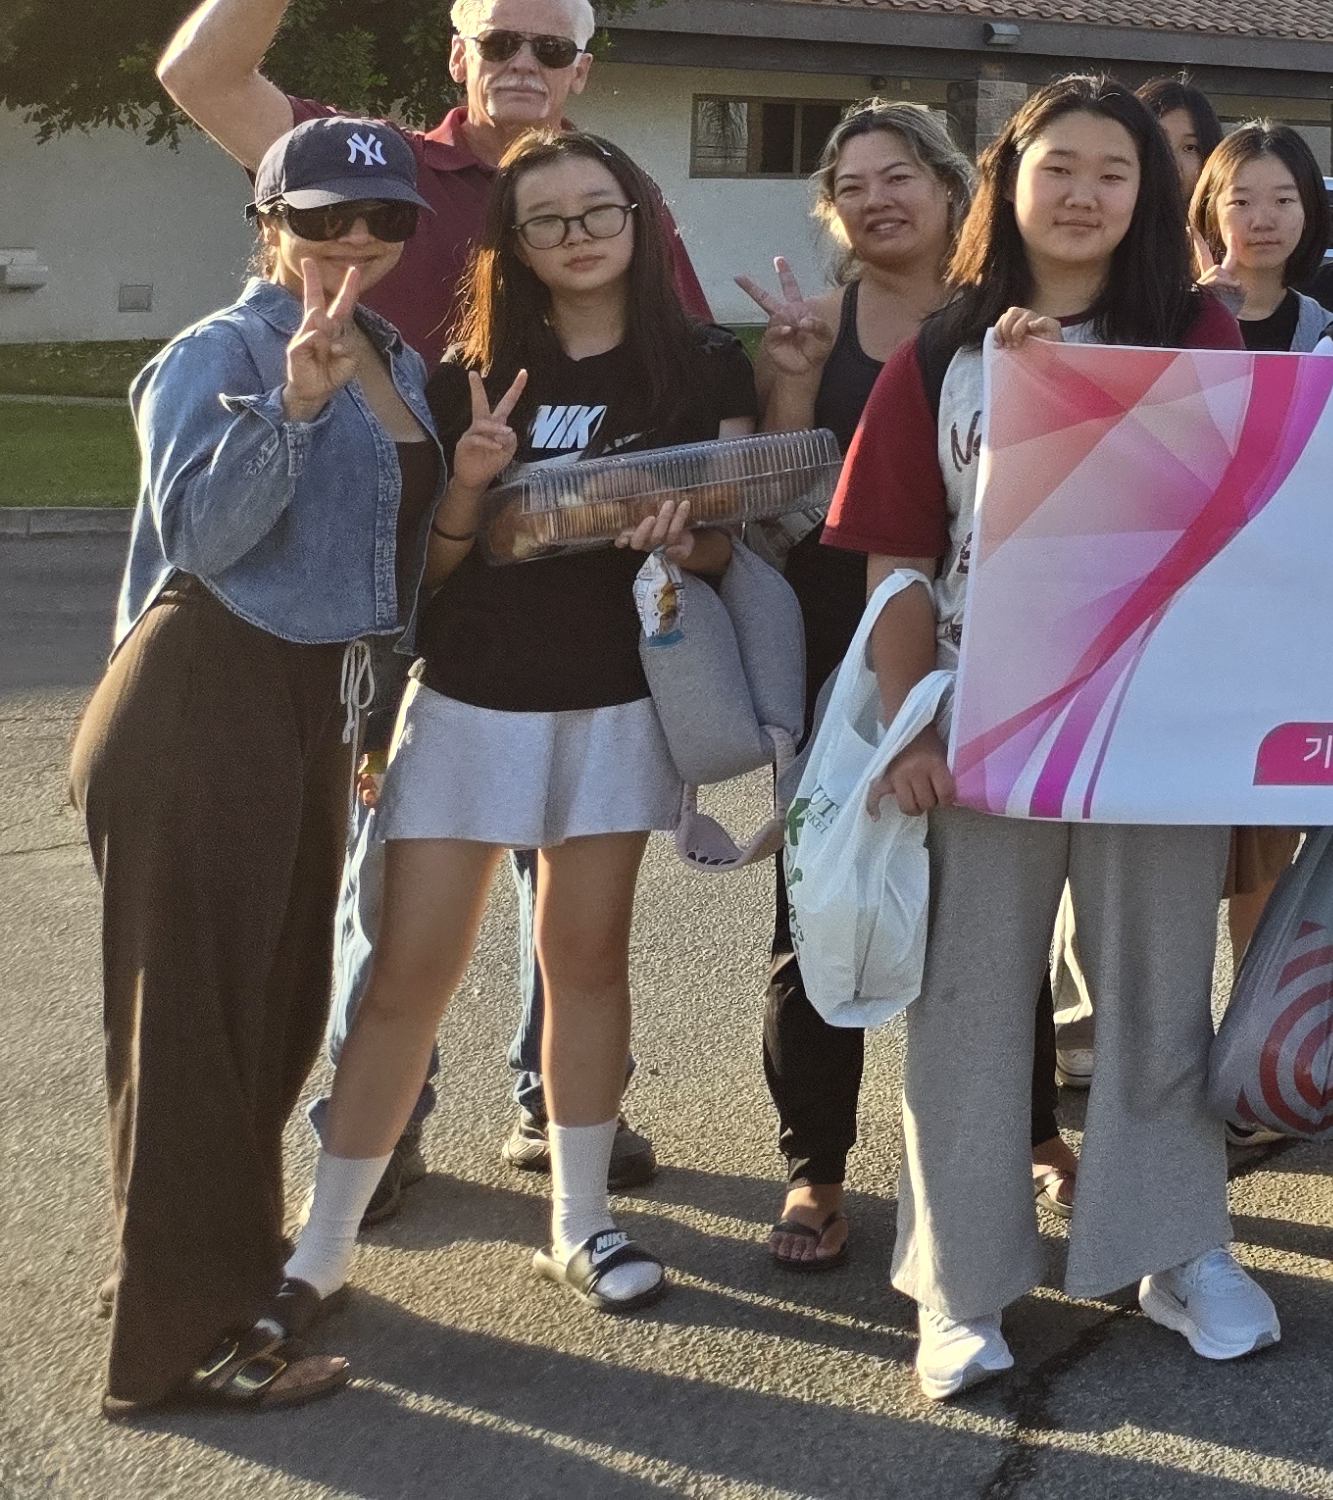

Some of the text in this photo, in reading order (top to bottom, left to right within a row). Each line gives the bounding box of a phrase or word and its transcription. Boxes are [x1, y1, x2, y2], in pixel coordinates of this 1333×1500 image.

[346, 132, 387, 166] NY
[531, 404, 608, 449] NIK
[597, 1231, 628, 1252] NIKE
